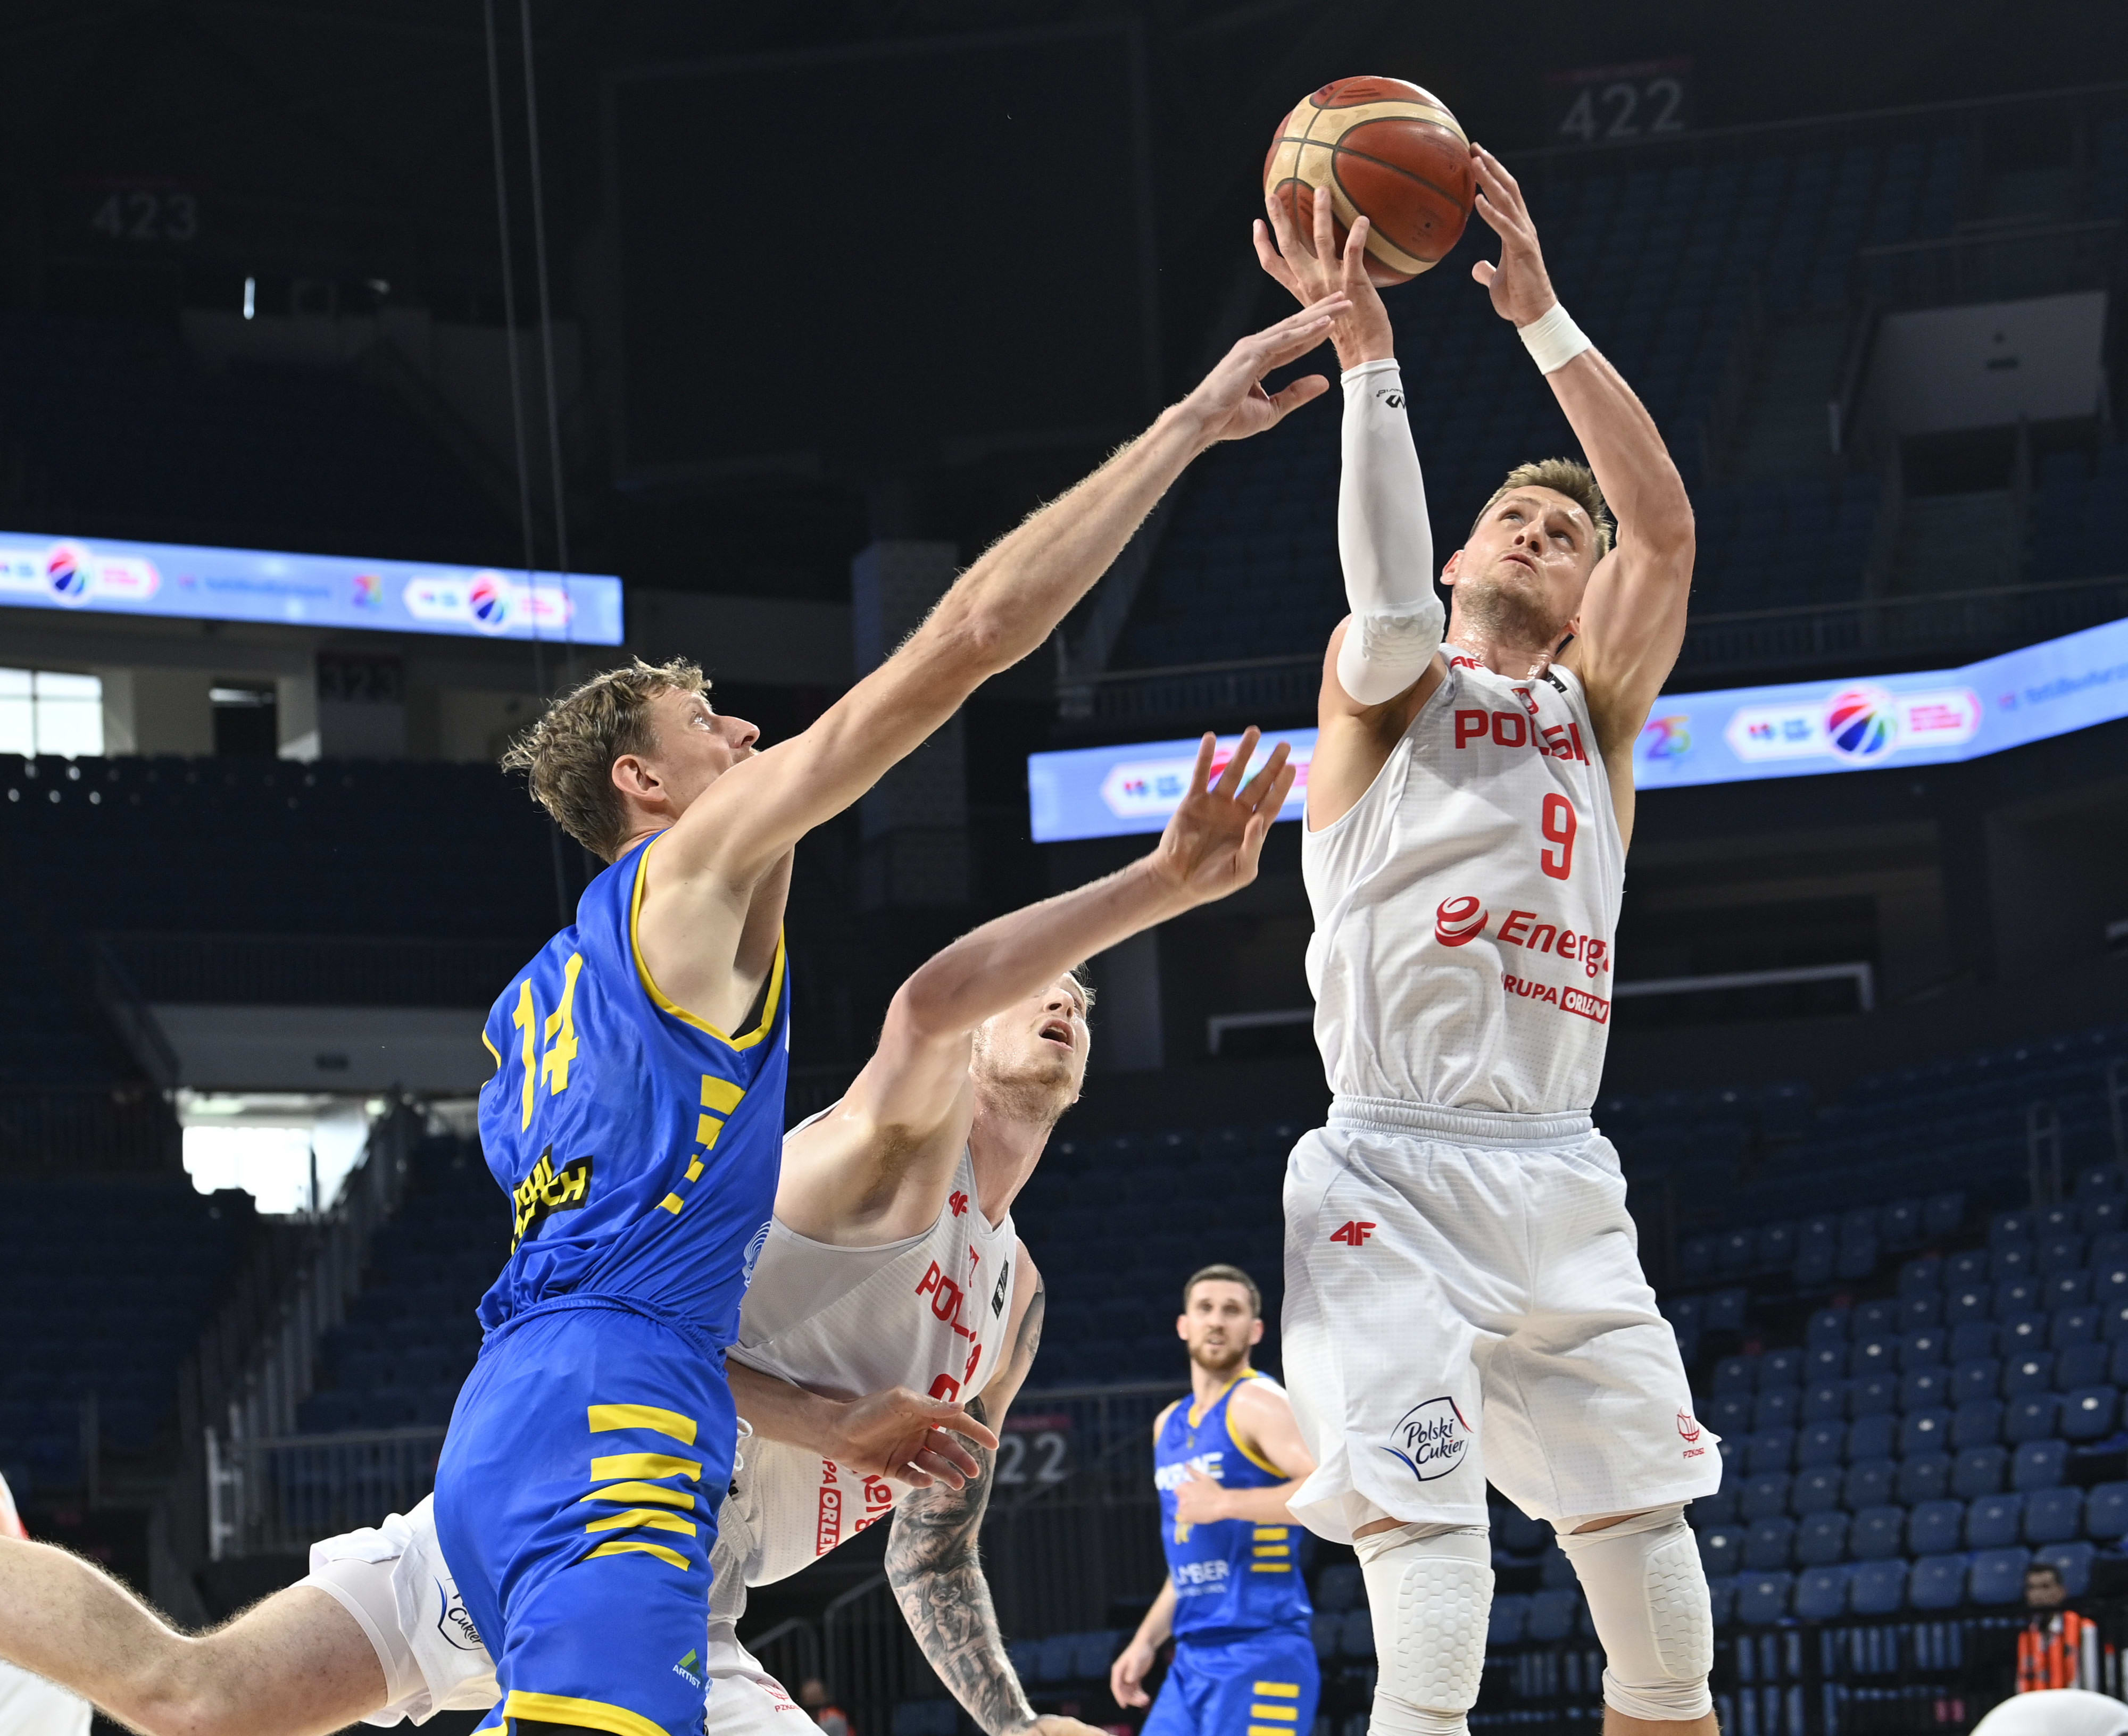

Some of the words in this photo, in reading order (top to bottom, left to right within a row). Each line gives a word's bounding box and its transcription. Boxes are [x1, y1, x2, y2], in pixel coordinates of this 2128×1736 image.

[1560, 78, 1684, 139] 422
[92, 192, 197, 240] 423
[1541, 793, 1576, 880] 9
[1501, 972, 1557, 1004] RUPA
[1565, 992, 1607, 1020] ORLEN
[512, 952, 583, 1133] 14
[1330, 1221, 1376, 1246] 4F
[1403, 1417, 1454, 1448] Polski
[1416, 1438, 1465, 1464] Cukier
[996, 1432, 1066, 1483] 22
[672, 1665, 700, 1689] ARTIST
